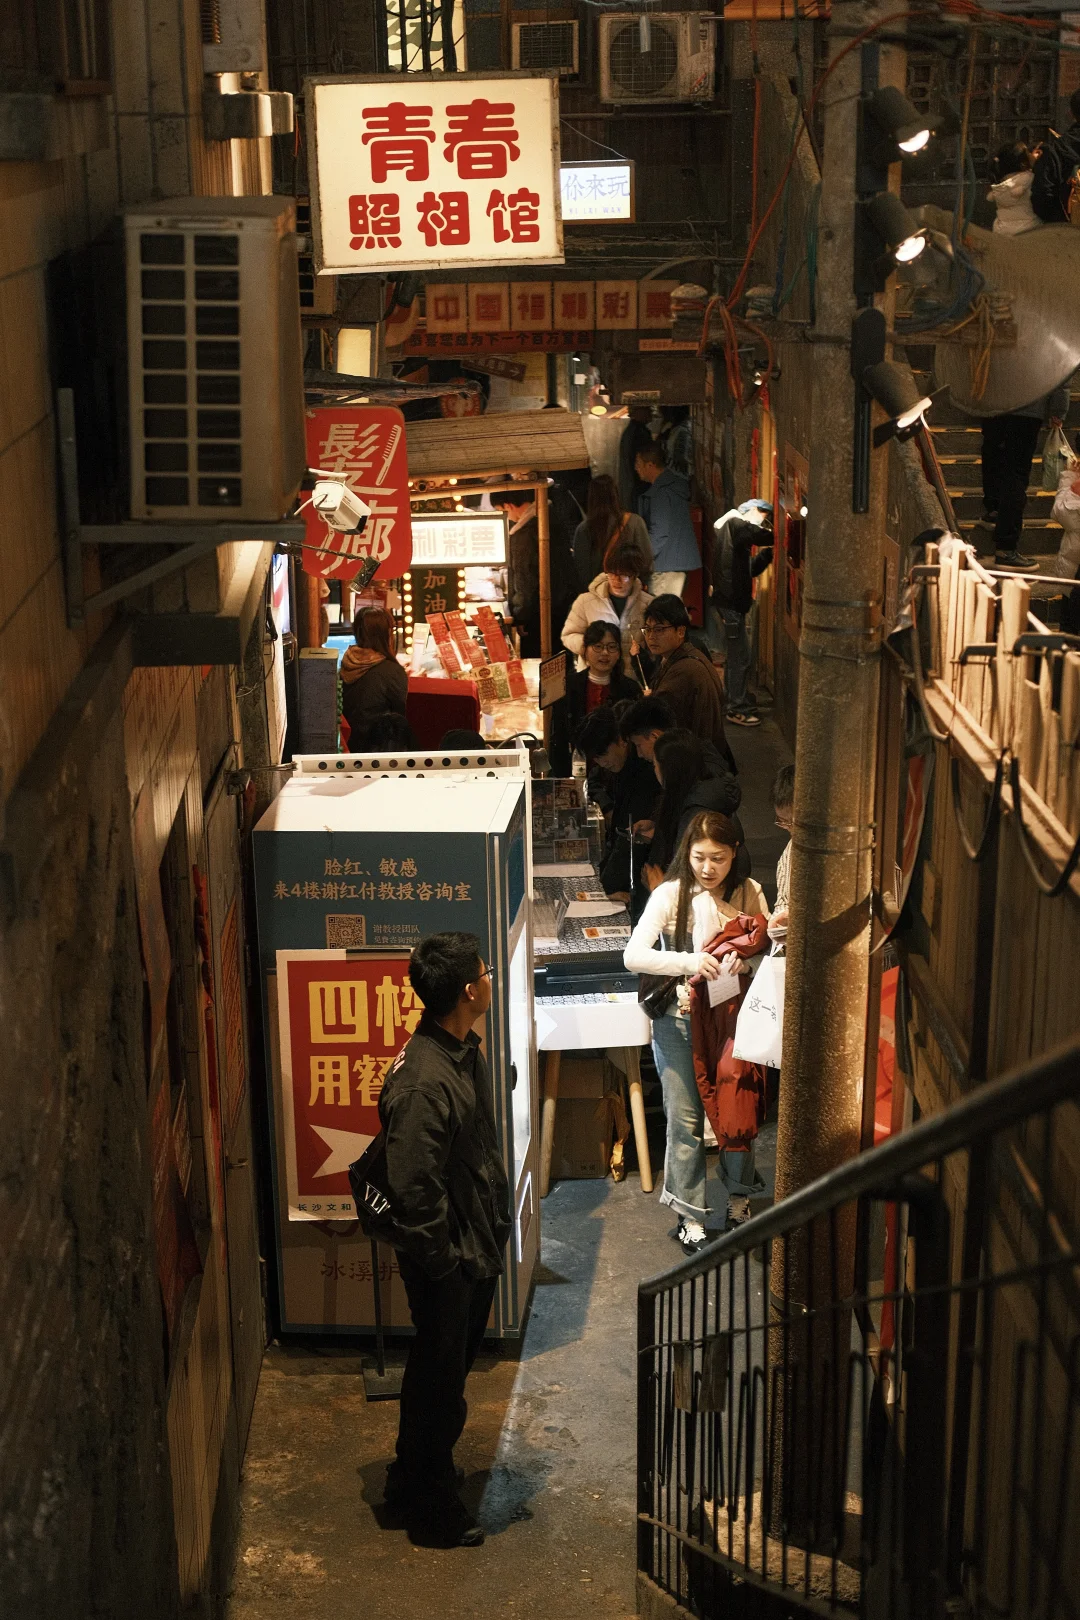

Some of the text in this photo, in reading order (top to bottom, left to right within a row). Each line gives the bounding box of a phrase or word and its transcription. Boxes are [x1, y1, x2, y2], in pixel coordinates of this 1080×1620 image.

[361, 98, 521, 184] 青春
[561, 173, 630, 202] 你來玩
[348, 187, 541, 251] 照相馆
[602, 206, 622, 214] WAN
[412, 525, 496, 558] 利彩票
[423, 569, 447, 613] 加油
[323, 857, 418, 878] 脸红、敏感
[273, 881, 472, 901] 来4楼谢红付教授咨询室
[372, 924, 420, 934] 谢教授团队
[297, 1203, 352, 1212] 长沙文和
